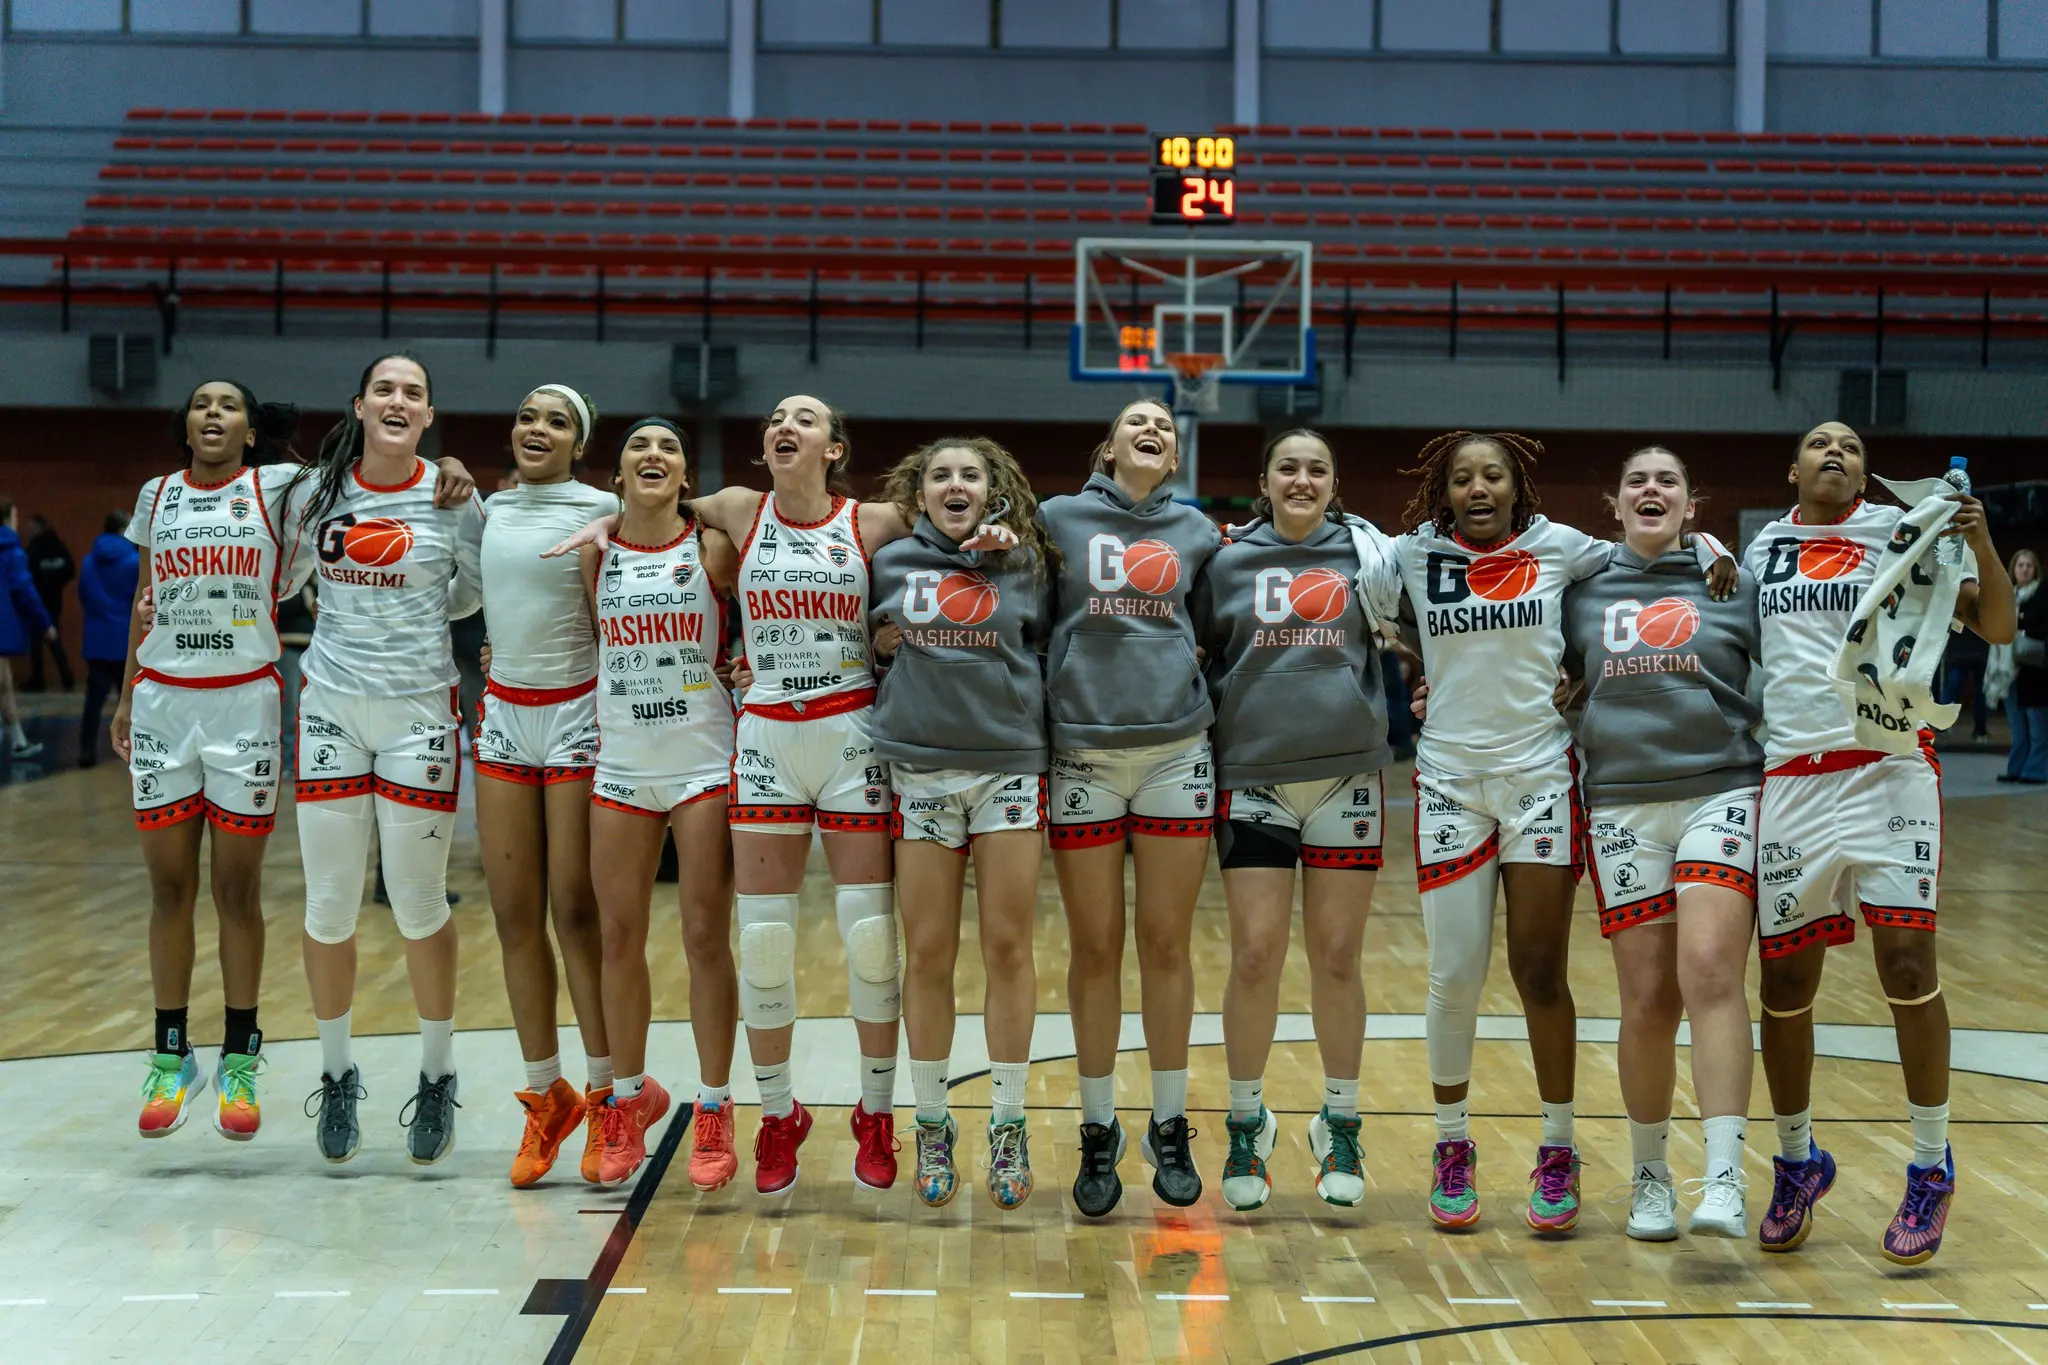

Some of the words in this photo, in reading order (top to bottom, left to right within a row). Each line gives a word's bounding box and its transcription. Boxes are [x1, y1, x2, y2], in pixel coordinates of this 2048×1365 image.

[1182, 177, 1233, 217] 24
[166, 486, 183, 502] 23
[156, 528, 182, 544] FAT
[185, 526, 256, 539] GROUP
[762, 523, 777, 540] 12
[155, 545, 261, 582] BASHKIMI
[611, 553, 620, 569] 4
[633, 563, 666, 572] apostrof
[636, 571, 659, 579] studio
[750, 570, 781, 582] FAT
[784, 571, 856, 585] GROUP
[601, 596, 625, 610] FAT
[628, 592, 697, 607] GROUP
[746, 589, 861, 623] BASHKIMI
[1761, 583, 1859, 618] BASHKIMI
[232, 604, 257, 619] flux
[1427, 599, 1543, 637] BASHKIMI
[172, 618, 212, 626] TOWERS
[904, 629, 998, 647] BASHKIMI
[1253, 628, 1345, 647] BASHKIMI
[776, 652, 821, 660] XHARRA
[778, 660, 821, 670] TOWERS
[1604, 654, 1699, 677] BASHKIMI
[682, 669, 708, 684] flux
[627, 687, 664, 697] TOWERS
[134, 732, 153, 741] HOTEL
[742, 748, 761, 757] HOTEL
[135, 758, 166, 769] ANNEX
[741, 755, 775, 769] DENIS
[740, 773, 776, 784] ANNEX
[602, 783, 636, 797] ANNEX
[908, 801, 947, 811] ANNEX
[1711, 824, 1752, 842] ZINKUNIE
[1601, 838, 1639, 855] ANNEX
[1762, 842, 1782, 850] HOTEL
[1762, 846, 1801, 864] DENIS
[1763, 867, 1803, 882] ANNEX
